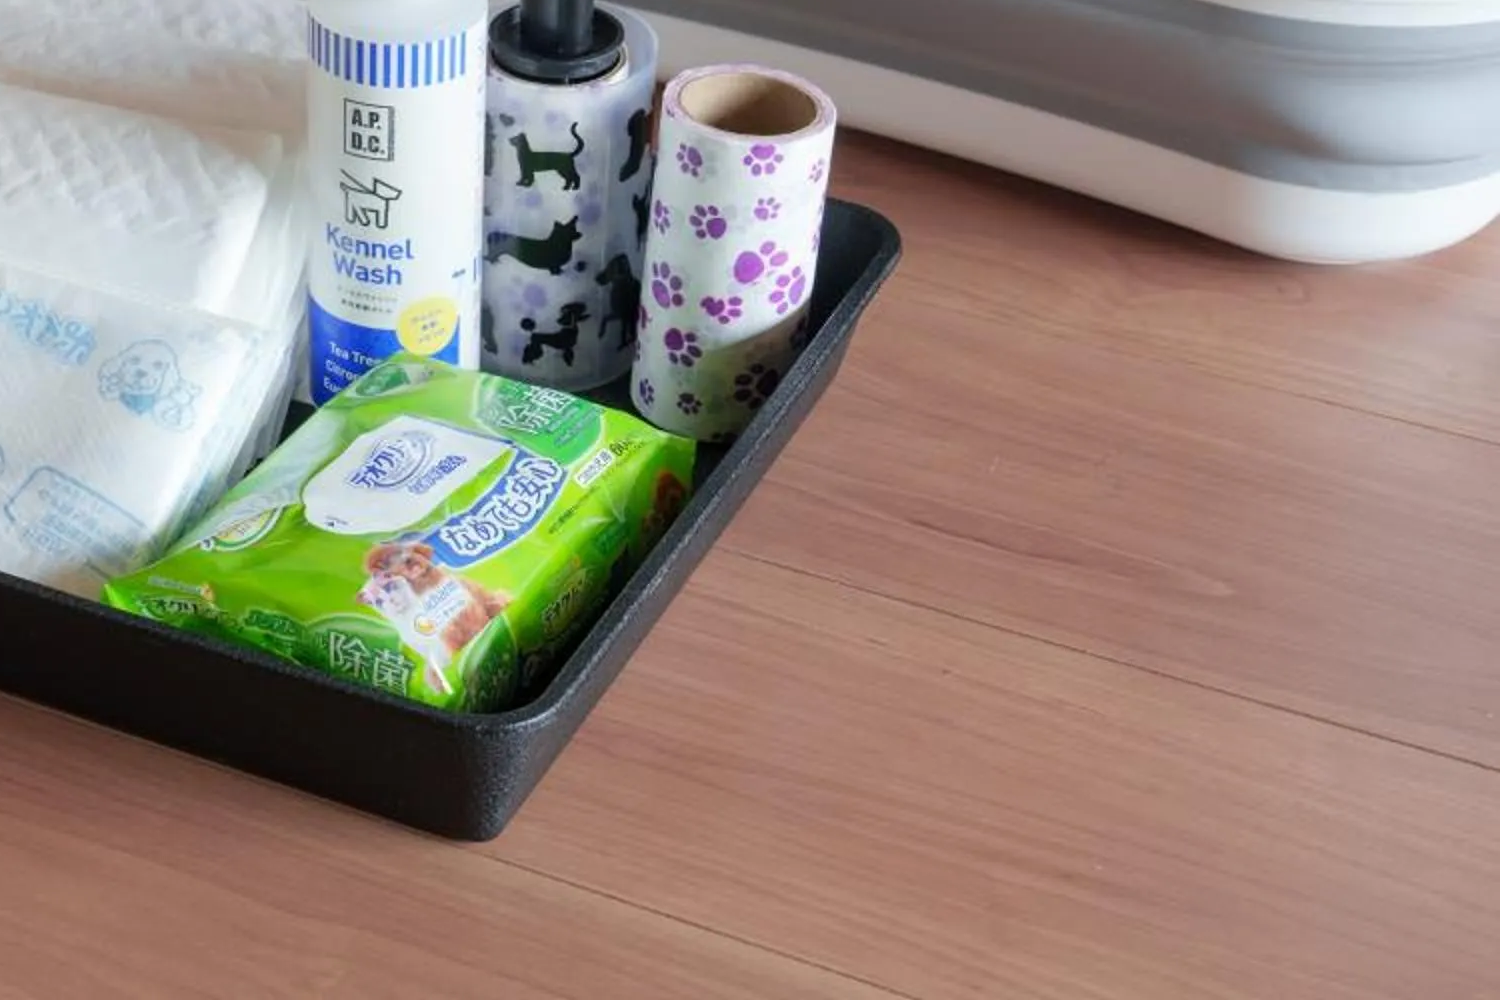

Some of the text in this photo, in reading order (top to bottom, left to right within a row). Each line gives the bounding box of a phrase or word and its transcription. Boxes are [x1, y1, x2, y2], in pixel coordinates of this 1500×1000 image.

[351, 108, 382, 130] A.P.
[351, 131, 386, 154] D.C.
[326, 222, 415, 260] Kennel
[333, 250, 402, 286] Wash
[328, 340, 349, 361] Tea
[445, 459, 559, 552] なめても安心
[329, 631, 415, 697] 除菌
